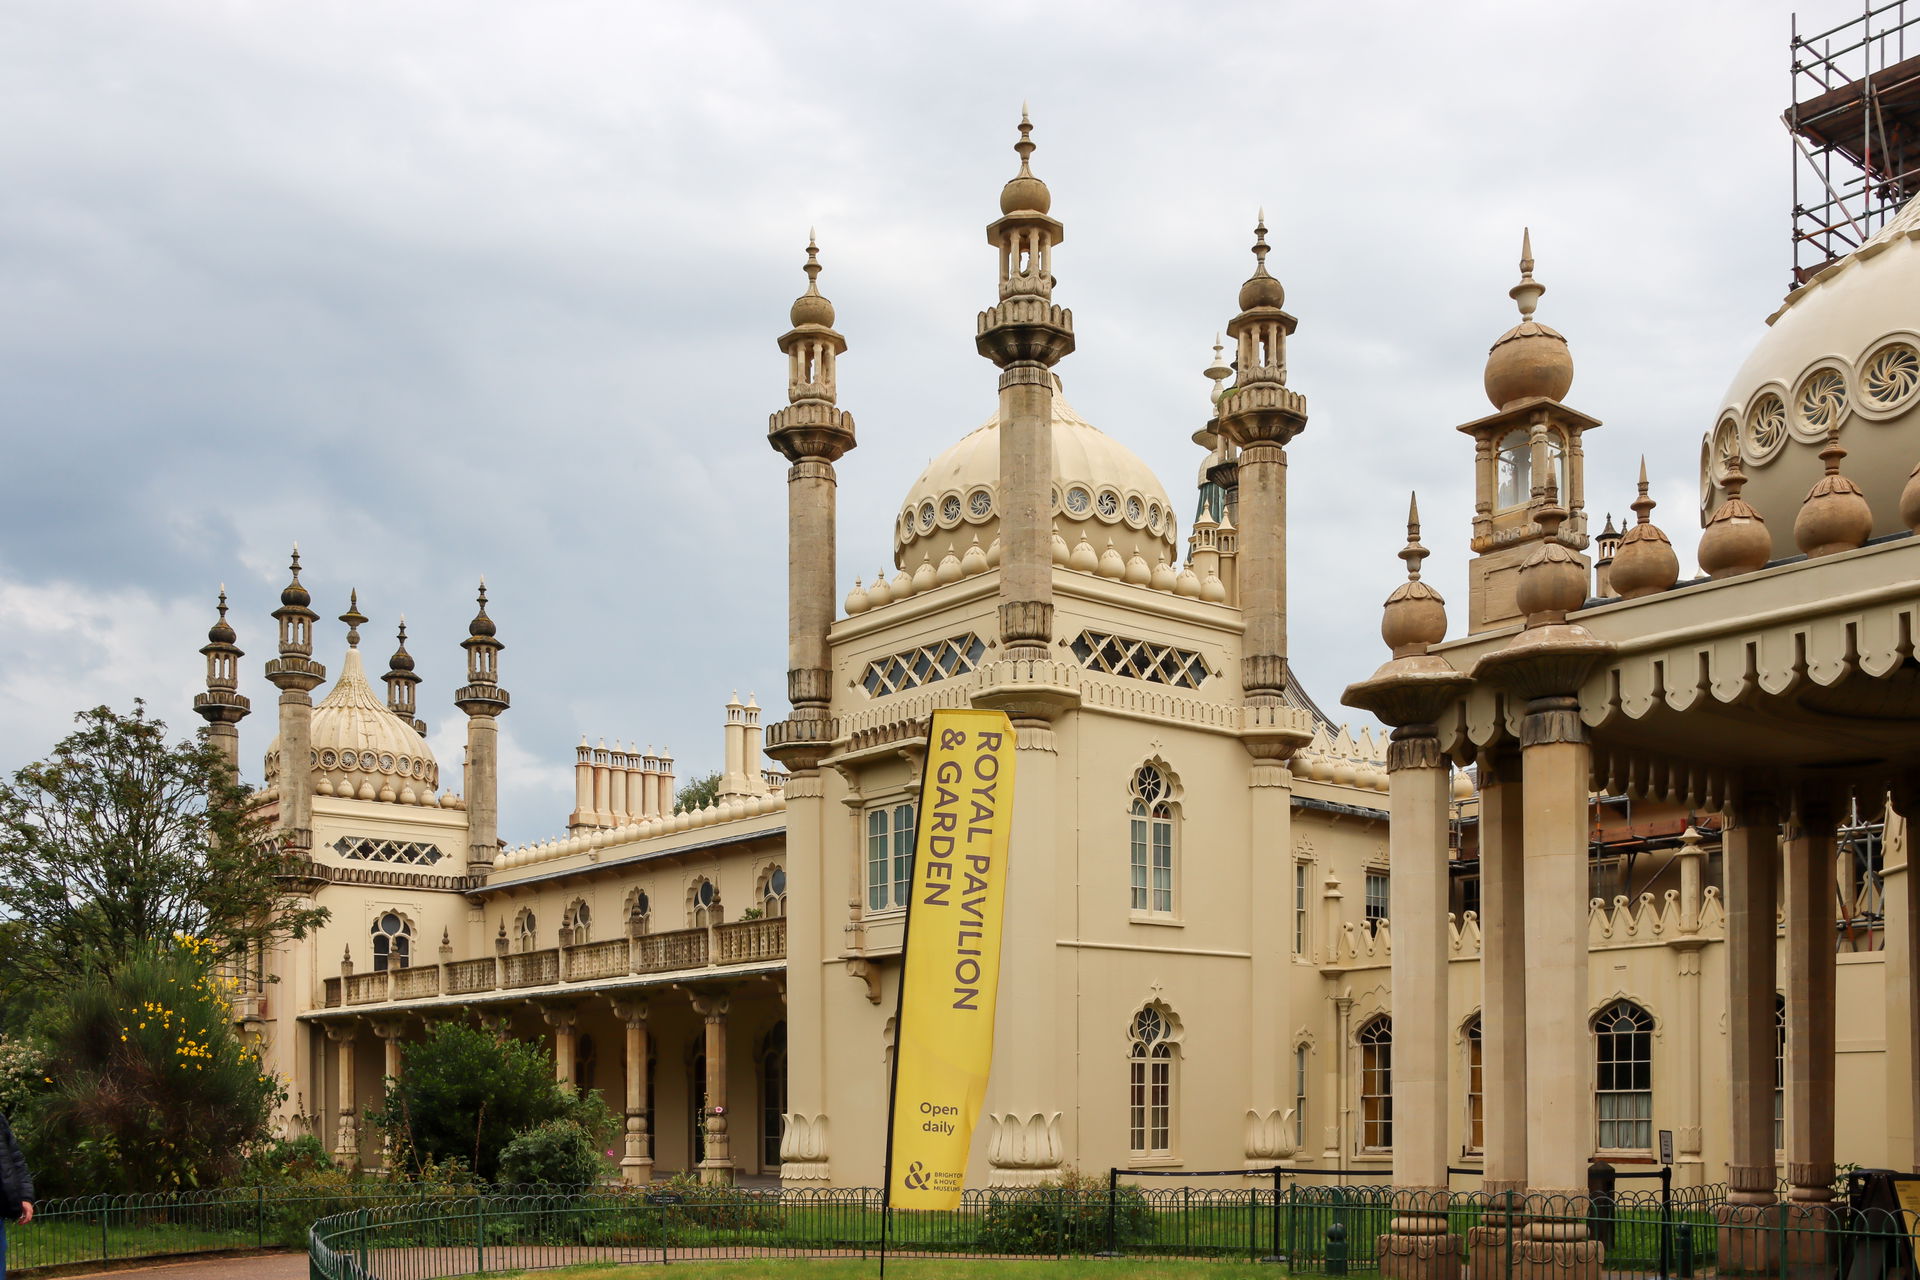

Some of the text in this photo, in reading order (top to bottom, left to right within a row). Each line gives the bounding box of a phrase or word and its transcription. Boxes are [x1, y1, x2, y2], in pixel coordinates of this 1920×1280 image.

[924, 728, 966, 906] & GARDEN
[953, 731, 1002, 1010] ROYAL PAVILION
[920, 1102, 958, 1117] Open
[922, 1121, 955, 1136] daily
